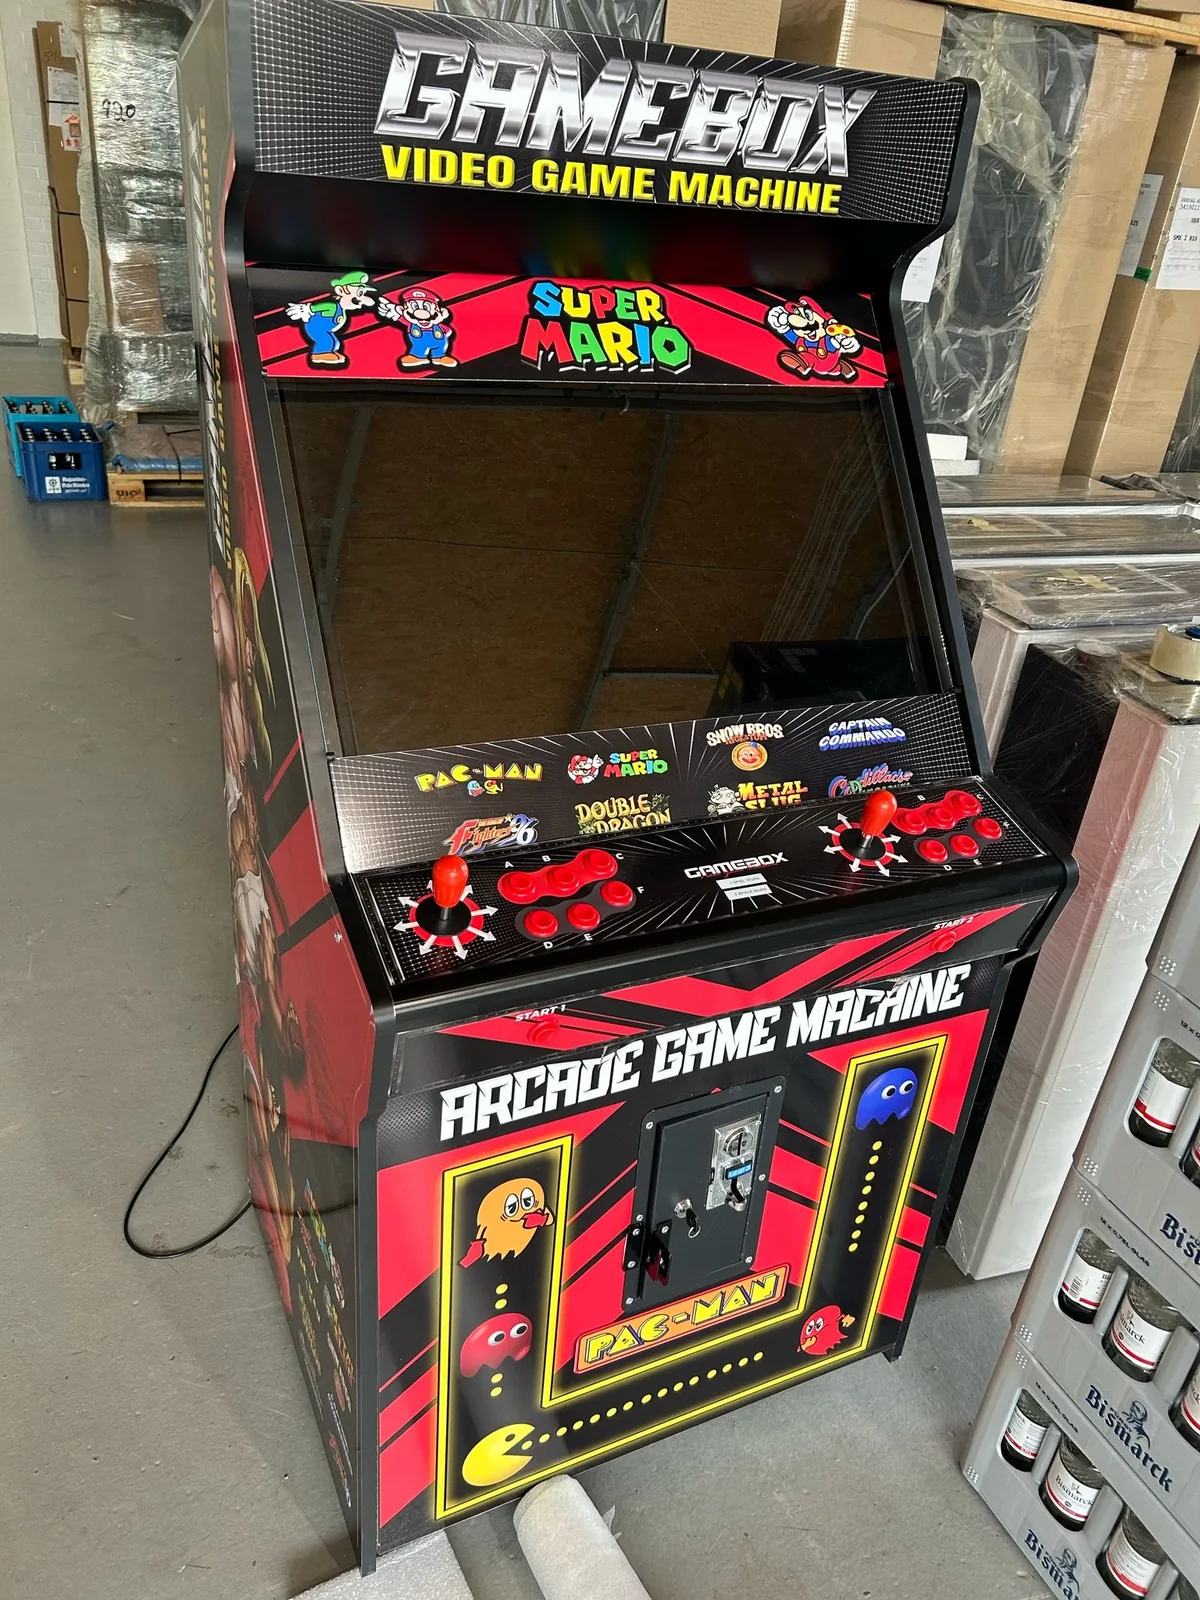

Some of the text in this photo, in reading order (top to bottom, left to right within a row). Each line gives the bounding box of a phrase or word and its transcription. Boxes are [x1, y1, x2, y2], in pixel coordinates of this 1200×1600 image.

[373, 29, 877, 177] GAMEBOX
[380, 143, 843, 214] VIDEO GAME MACHINE
[532, 282, 665, 322] SUPER
[199, 106, 233, 570] VIDEO GAME MACHINE
[520, 317, 690, 371] MARIO
[706, 724, 745, 747] SNOW
[828, 716, 892, 735] CAPTAIN
[818, 727, 907, 752] COMMANDO
[609, 748, 659, 763] SUPER
[414, 761, 545, 792] PAC-MAN
[603, 759, 668, 779] MARIO
[738, 781, 808, 800] METAL
[575, 794, 651, 822] DOUBLE
[593, 808, 672, 834] DRAGON
[615, 852, 624, 860] C
[684, 852, 789, 879] GAMEBOX
[638, 886, 645, 894] F
[933, 916, 974, 931] START 2
[543, 941, 553, 949] D
[584, 933, 593, 941] E
[515, 1004, 566, 1022] START 1
[1180, 1020, 1188, 1029] 12
[439, 965, 972, 1142] ARCADE GAME MACHINE
[1131, 1247, 1150, 1267] GLAS
[585, 1272, 780, 1363] PAC-MAN
[1085, 1385, 1173, 1493] Bismarck
[1055, 1475, 1094, 1507] Bismarck
